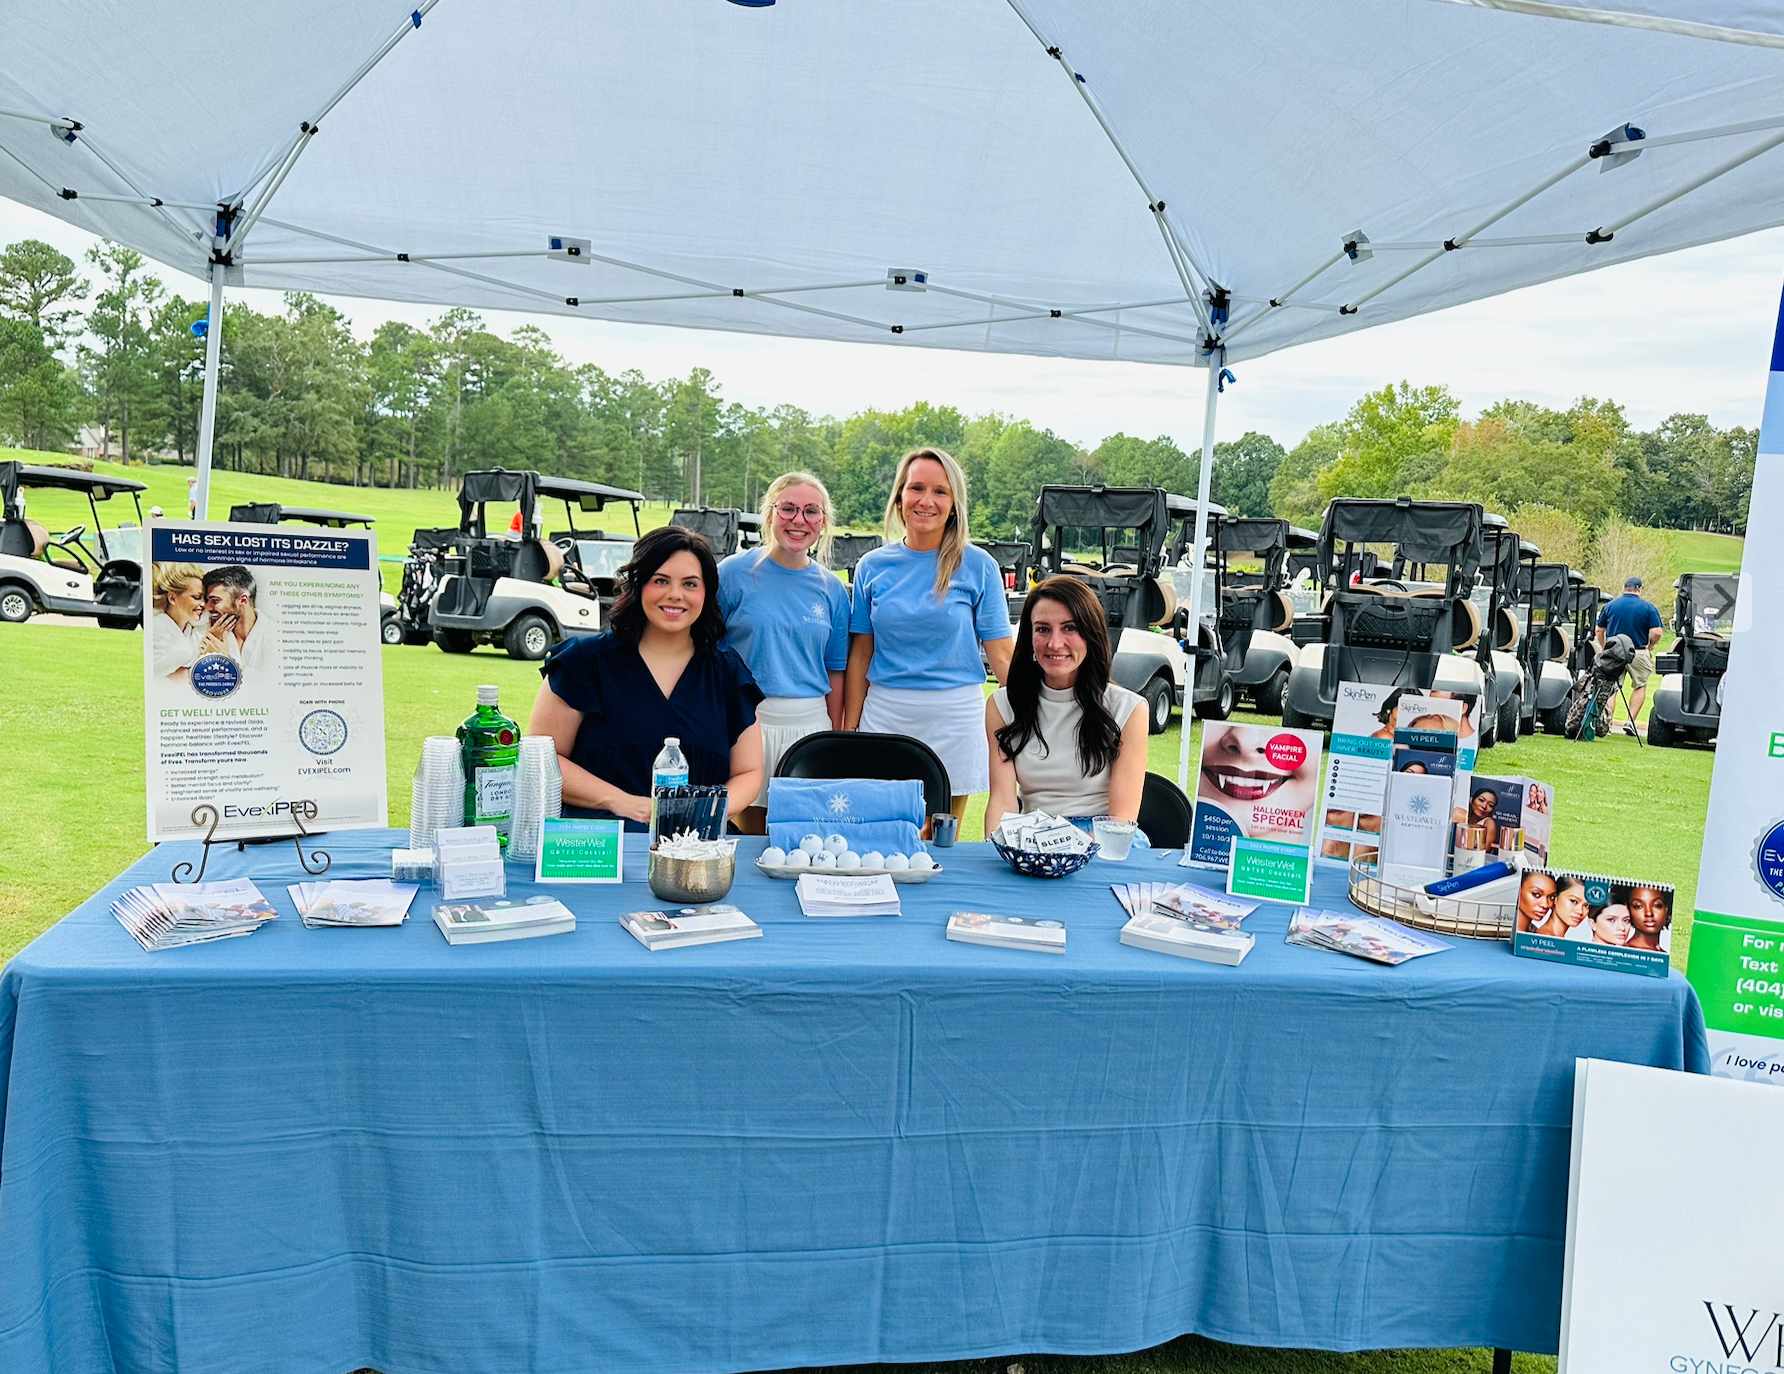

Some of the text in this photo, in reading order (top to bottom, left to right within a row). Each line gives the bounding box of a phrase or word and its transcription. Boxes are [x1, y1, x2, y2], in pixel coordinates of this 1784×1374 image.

[172, 533, 349, 552] HAS SEX LOST ITS DAZZLE?
[300, 552, 336, 560] performance
[1344, 687, 1376, 700] SkinPen
[161, 709, 179, 717] GET
[182, 709, 212, 717] WELL!
[239, 708, 269, 716] WELL!
[1401, 703, 1427, 713] SkinPen
[1337, 737, 1357, 745] BRING
[1269, 743, 1303, 754] VAMPIRE
[1272, 752, 1298, 762] FACIAL
[298, 767, 351, 775] EVEXIPEL.com
[1253, 805, 1306, 818] HALLOWEEN
[1204, 815, 1221, 823] $450
[1252, 813, 1304, 829] SPECIAL
[1394, 813, 1441, 825] WESTERWELL
[1401, 822, 1433, 830] AESTHETICS
[555, 838, 606, 847] WesterWell
[1041, 836, 1071, 847] SLEEP
[1246, 855, 1295, 870] WesterWell
[1269, 870, 1301, 878] Cocktail
[1770, 868, 1783, 877] THE
[1437, 881, 1459, 892] SkinPen
[1539, 940, 1555, 948] PEEL
[1743, 934, 1774, 950] For
[1582, 947, 1607, 955] FLAWLESS
[1608, 950, 1639, 960] COMPLEXION
[1740, 956, 1779, 973] Text
[1733, 1002, 1784, 1018] or vis
[1726, 1055, 1732, 1065] I
[1734, 1055, 1766, 1070] love
